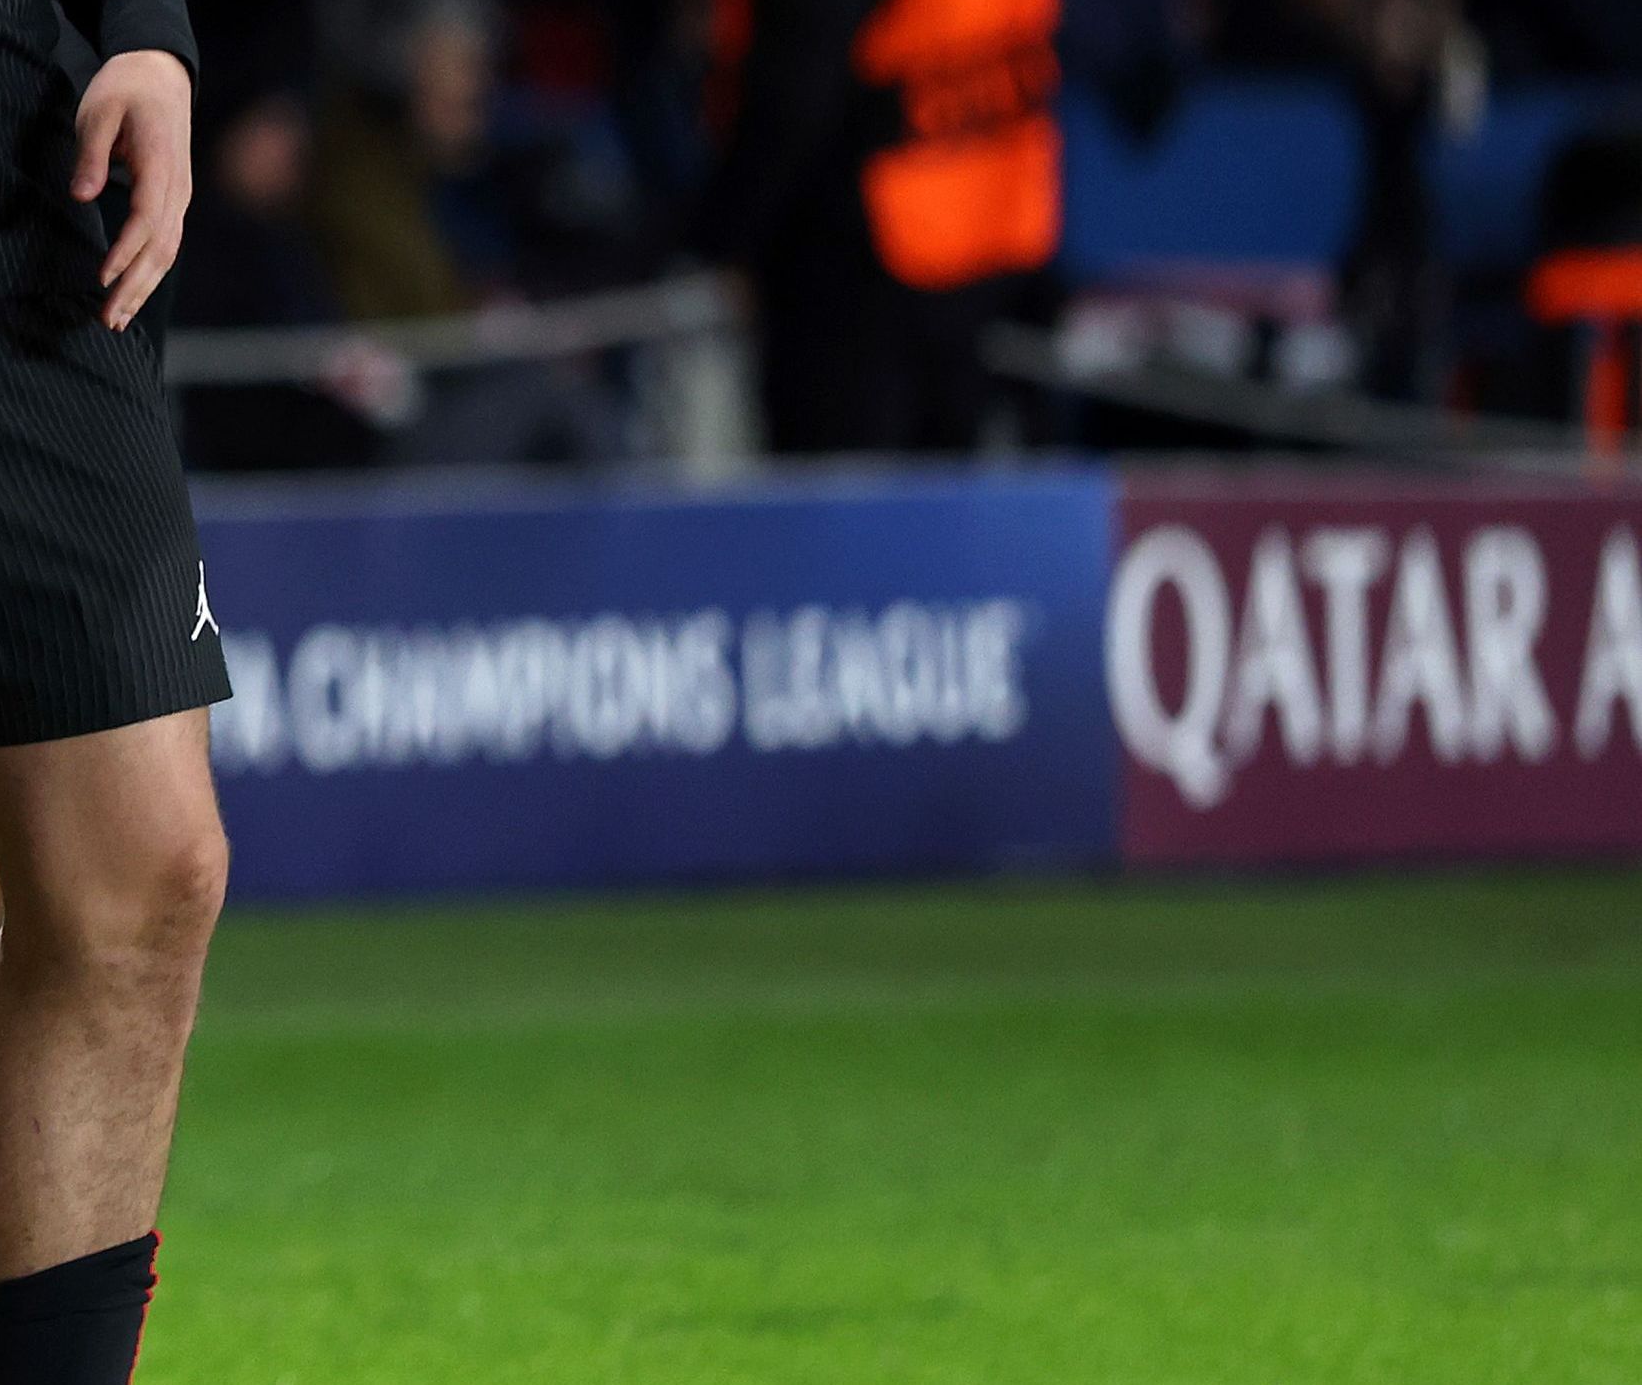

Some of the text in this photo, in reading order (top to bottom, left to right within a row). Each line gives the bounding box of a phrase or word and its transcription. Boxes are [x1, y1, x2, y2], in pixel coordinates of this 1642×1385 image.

[290, 610, 736, 772] CHAMPIONS
[744, 602, 1028, 752] LEAGUE
[1105, 522, 1557, 812] QATAR
